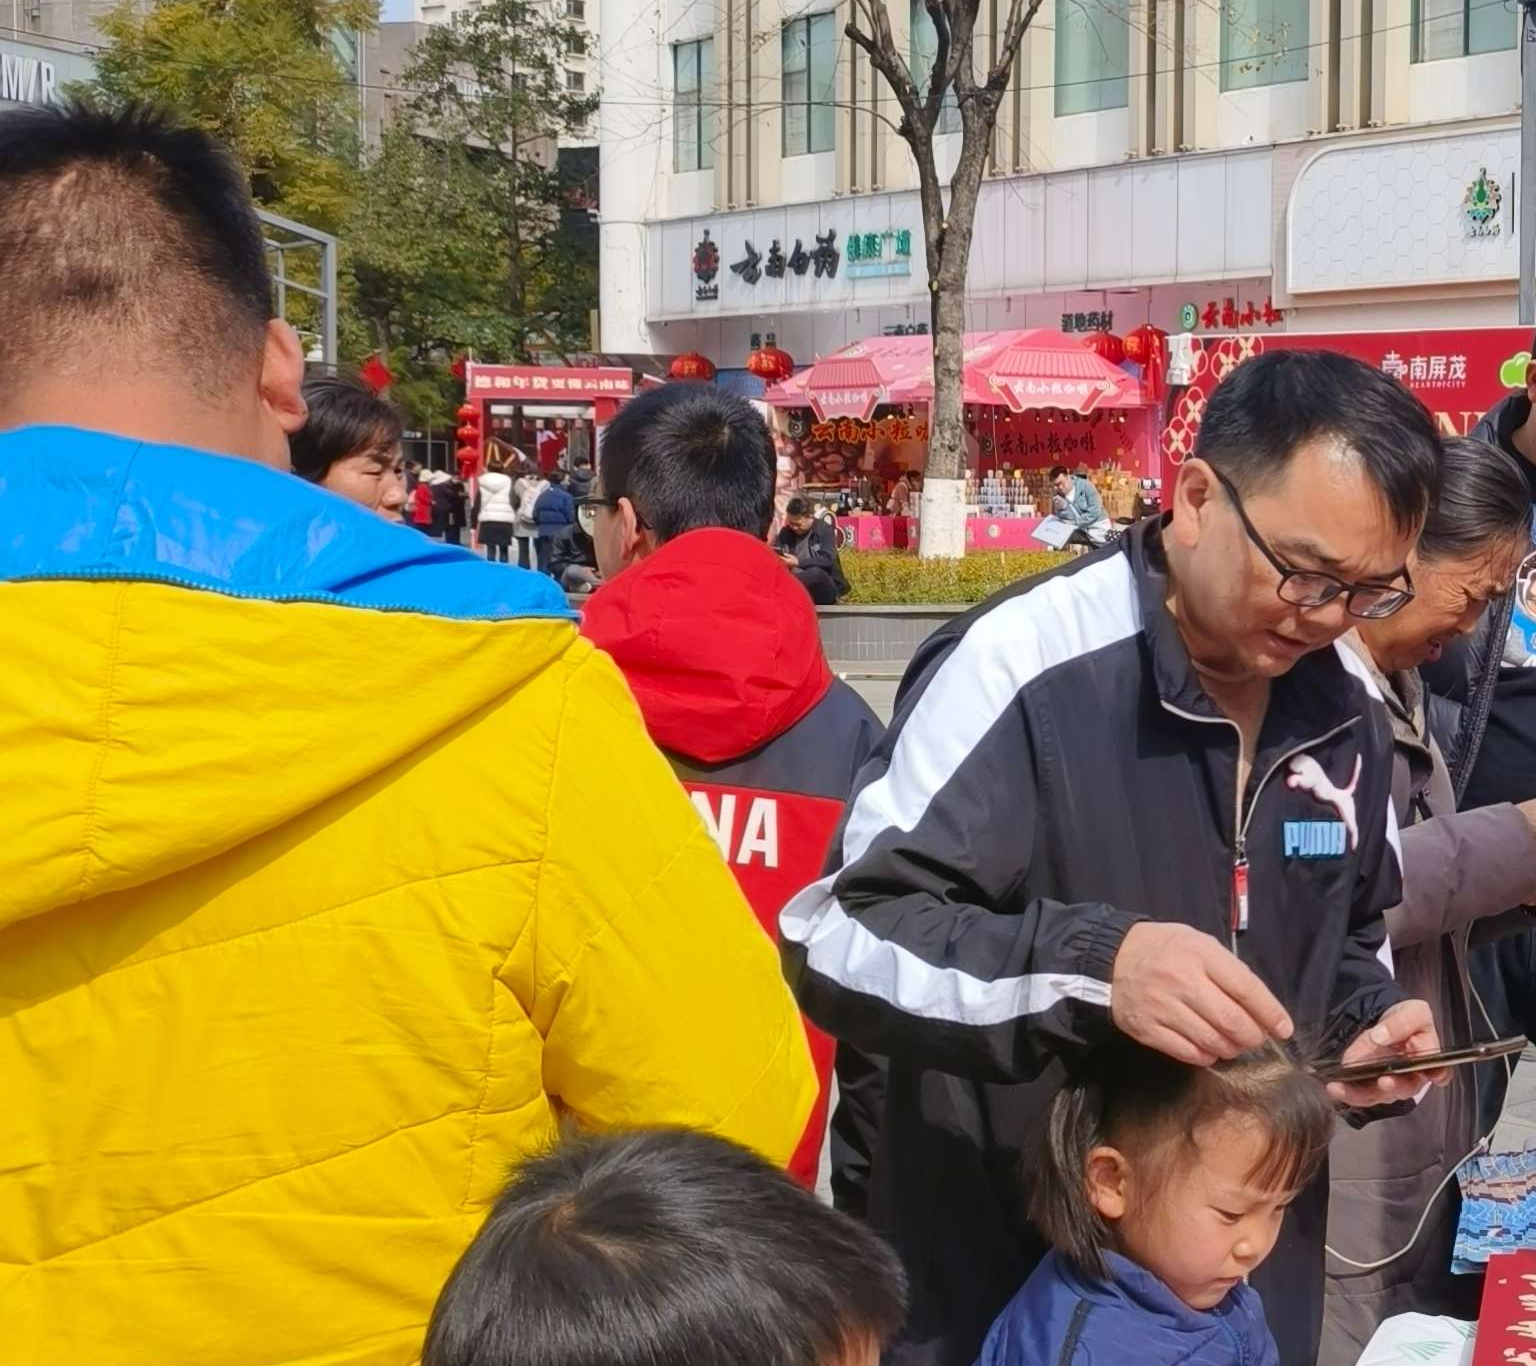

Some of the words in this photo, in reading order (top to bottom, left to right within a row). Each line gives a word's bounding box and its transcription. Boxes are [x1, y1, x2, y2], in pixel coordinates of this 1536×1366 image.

[730, 228, 840, 285] 云南白药
[1061, 311, 1114, 333] 道地药材
[1410, 355, 1467, 380] 南屏茂
